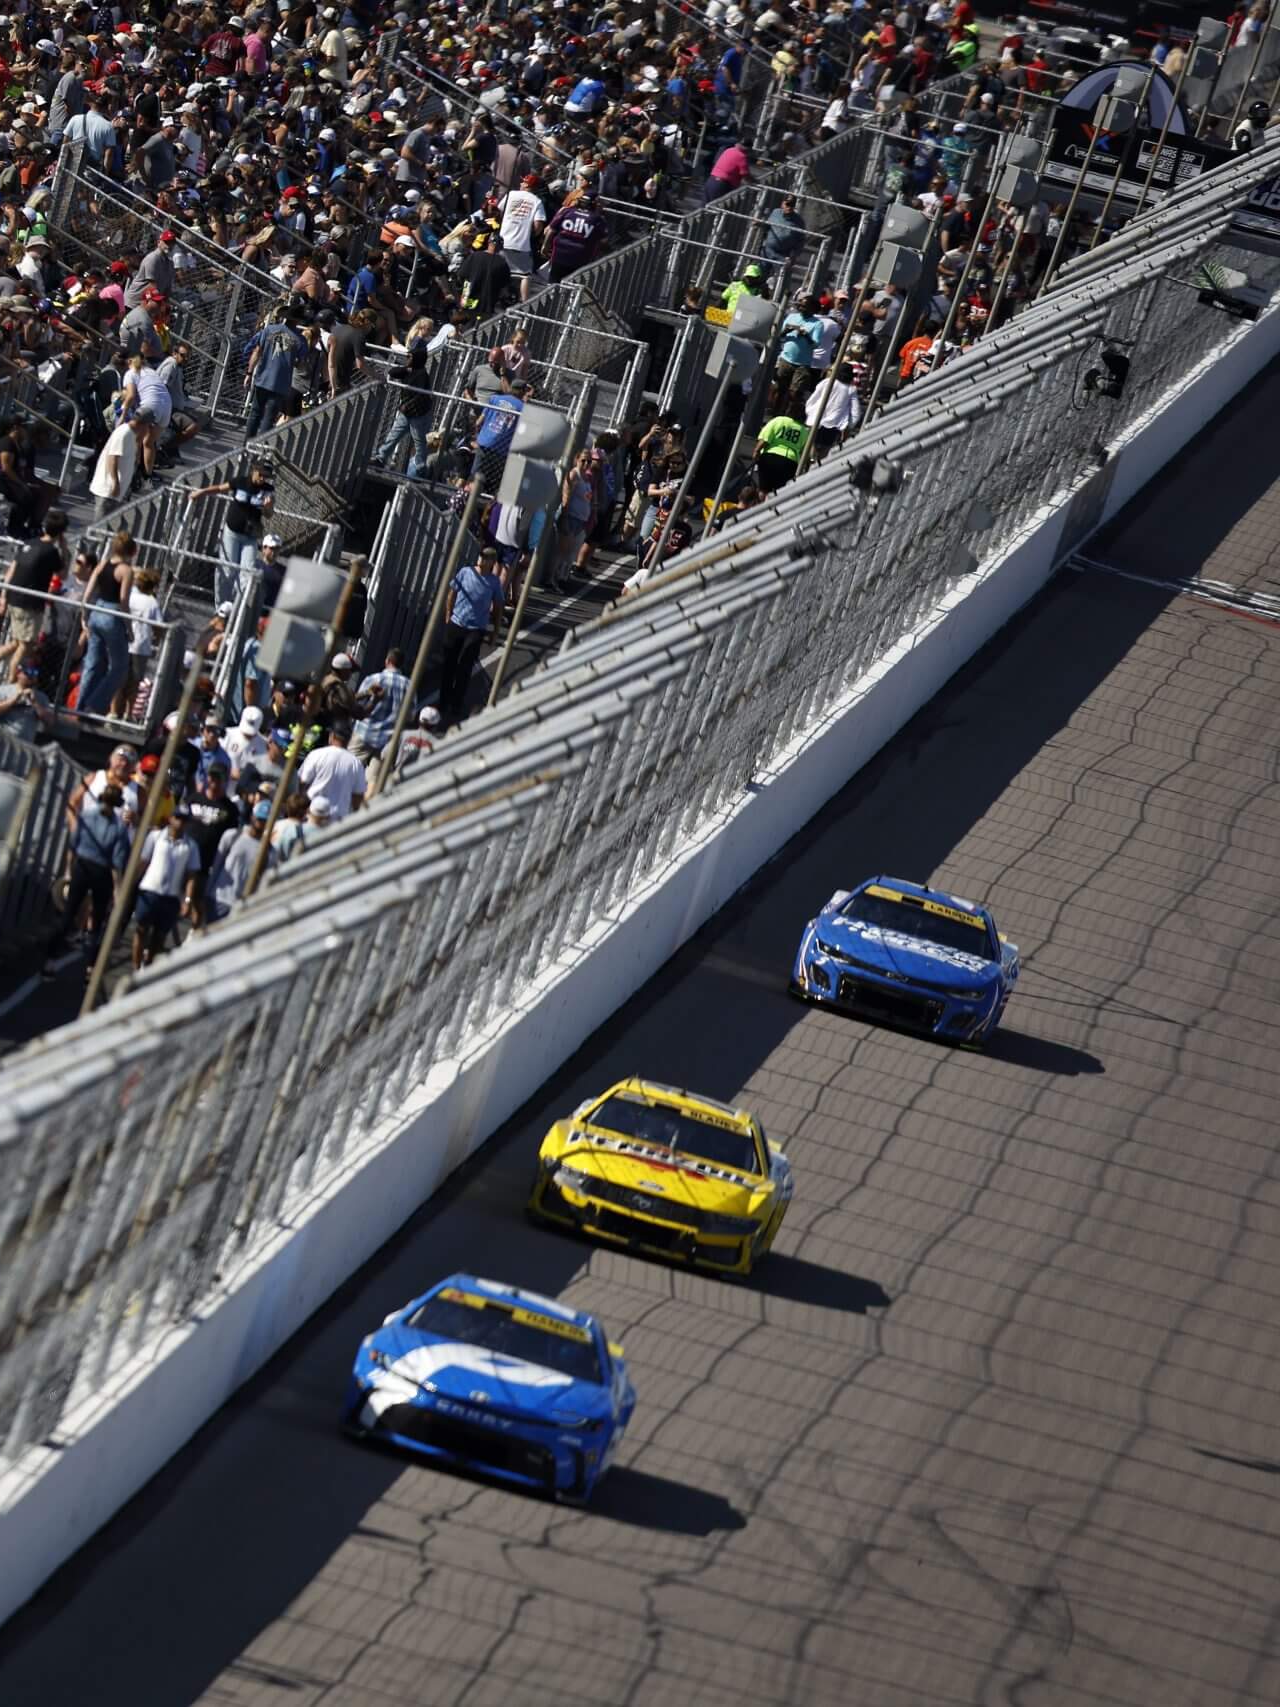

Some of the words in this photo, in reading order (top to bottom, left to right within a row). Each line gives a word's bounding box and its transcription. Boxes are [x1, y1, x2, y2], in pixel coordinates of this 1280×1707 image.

[561, 218, 595, 238] ally
[930, 904, 975, 923] LARSON
[690, 1110, 742, 1130] BLANEY
